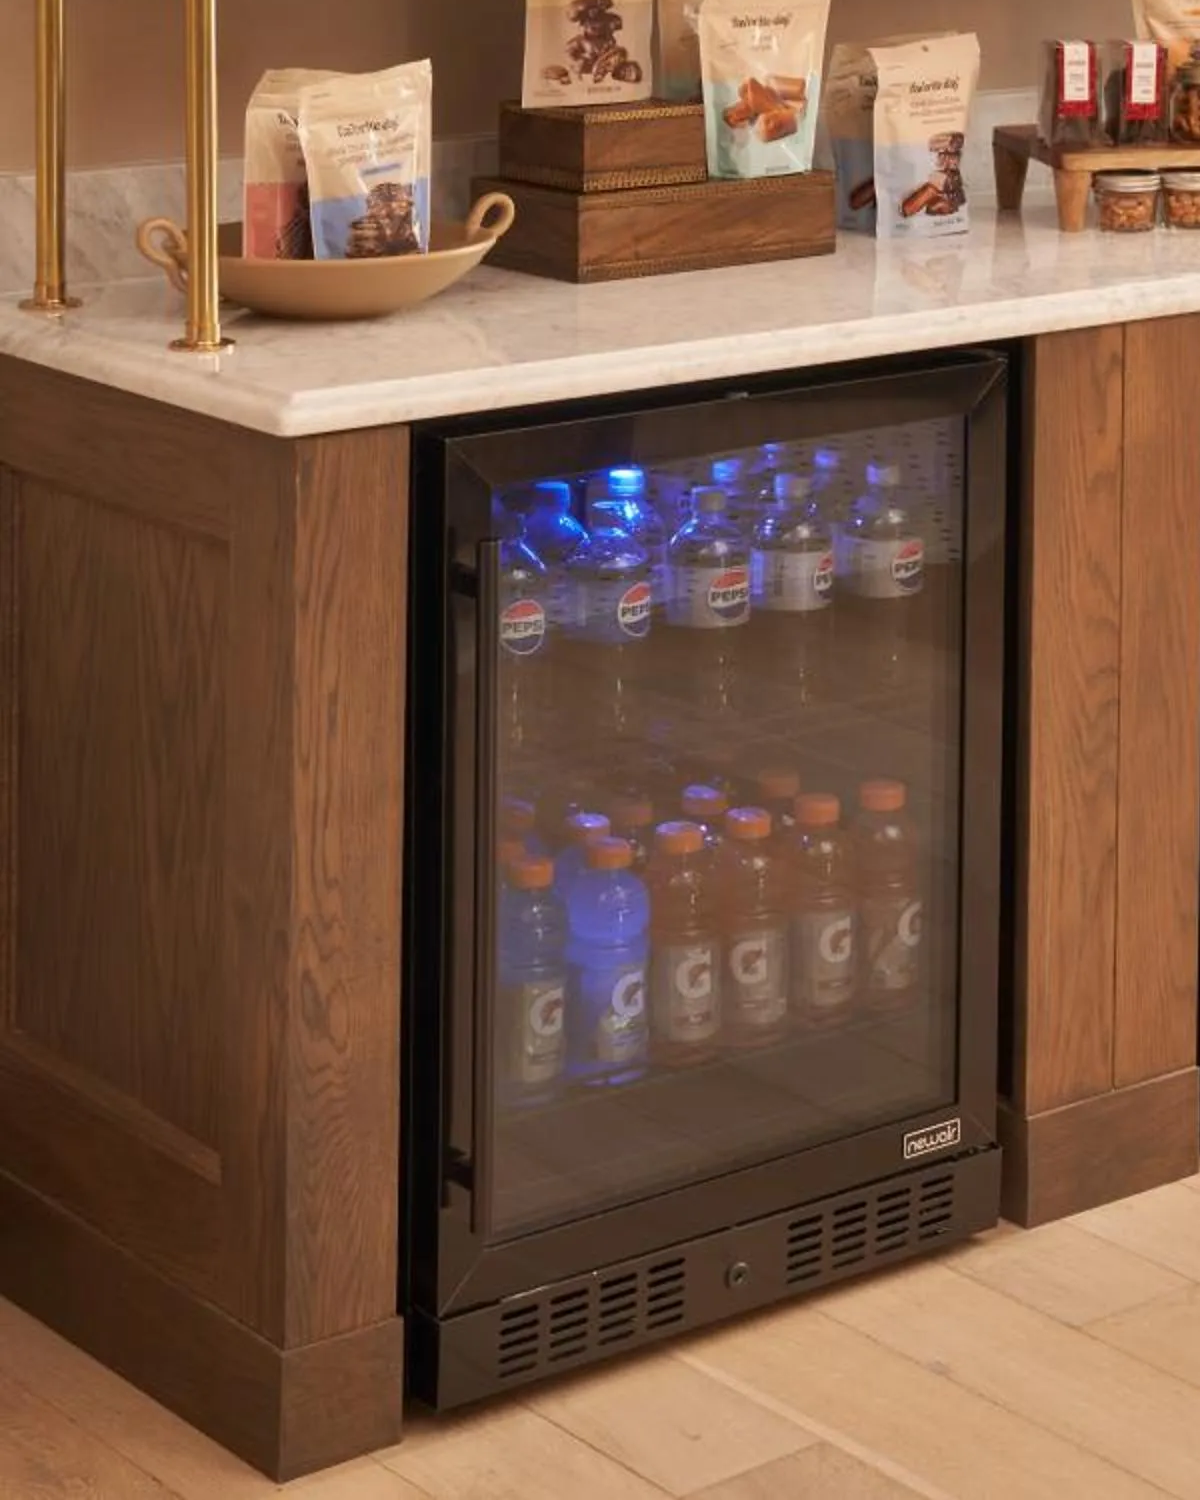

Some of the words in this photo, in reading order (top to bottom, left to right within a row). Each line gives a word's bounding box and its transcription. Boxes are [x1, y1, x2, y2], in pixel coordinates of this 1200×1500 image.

[711, 588, 748, 603] PEPS
[502, 619, 543, 634] PEPS
[730, 938, 767, 984] G
[819, 916, 851, 963] G
[530, 988, 563, 1036] G
[612, 969, 644, 1018] G
[907, 1125, 957, 1153] newair
